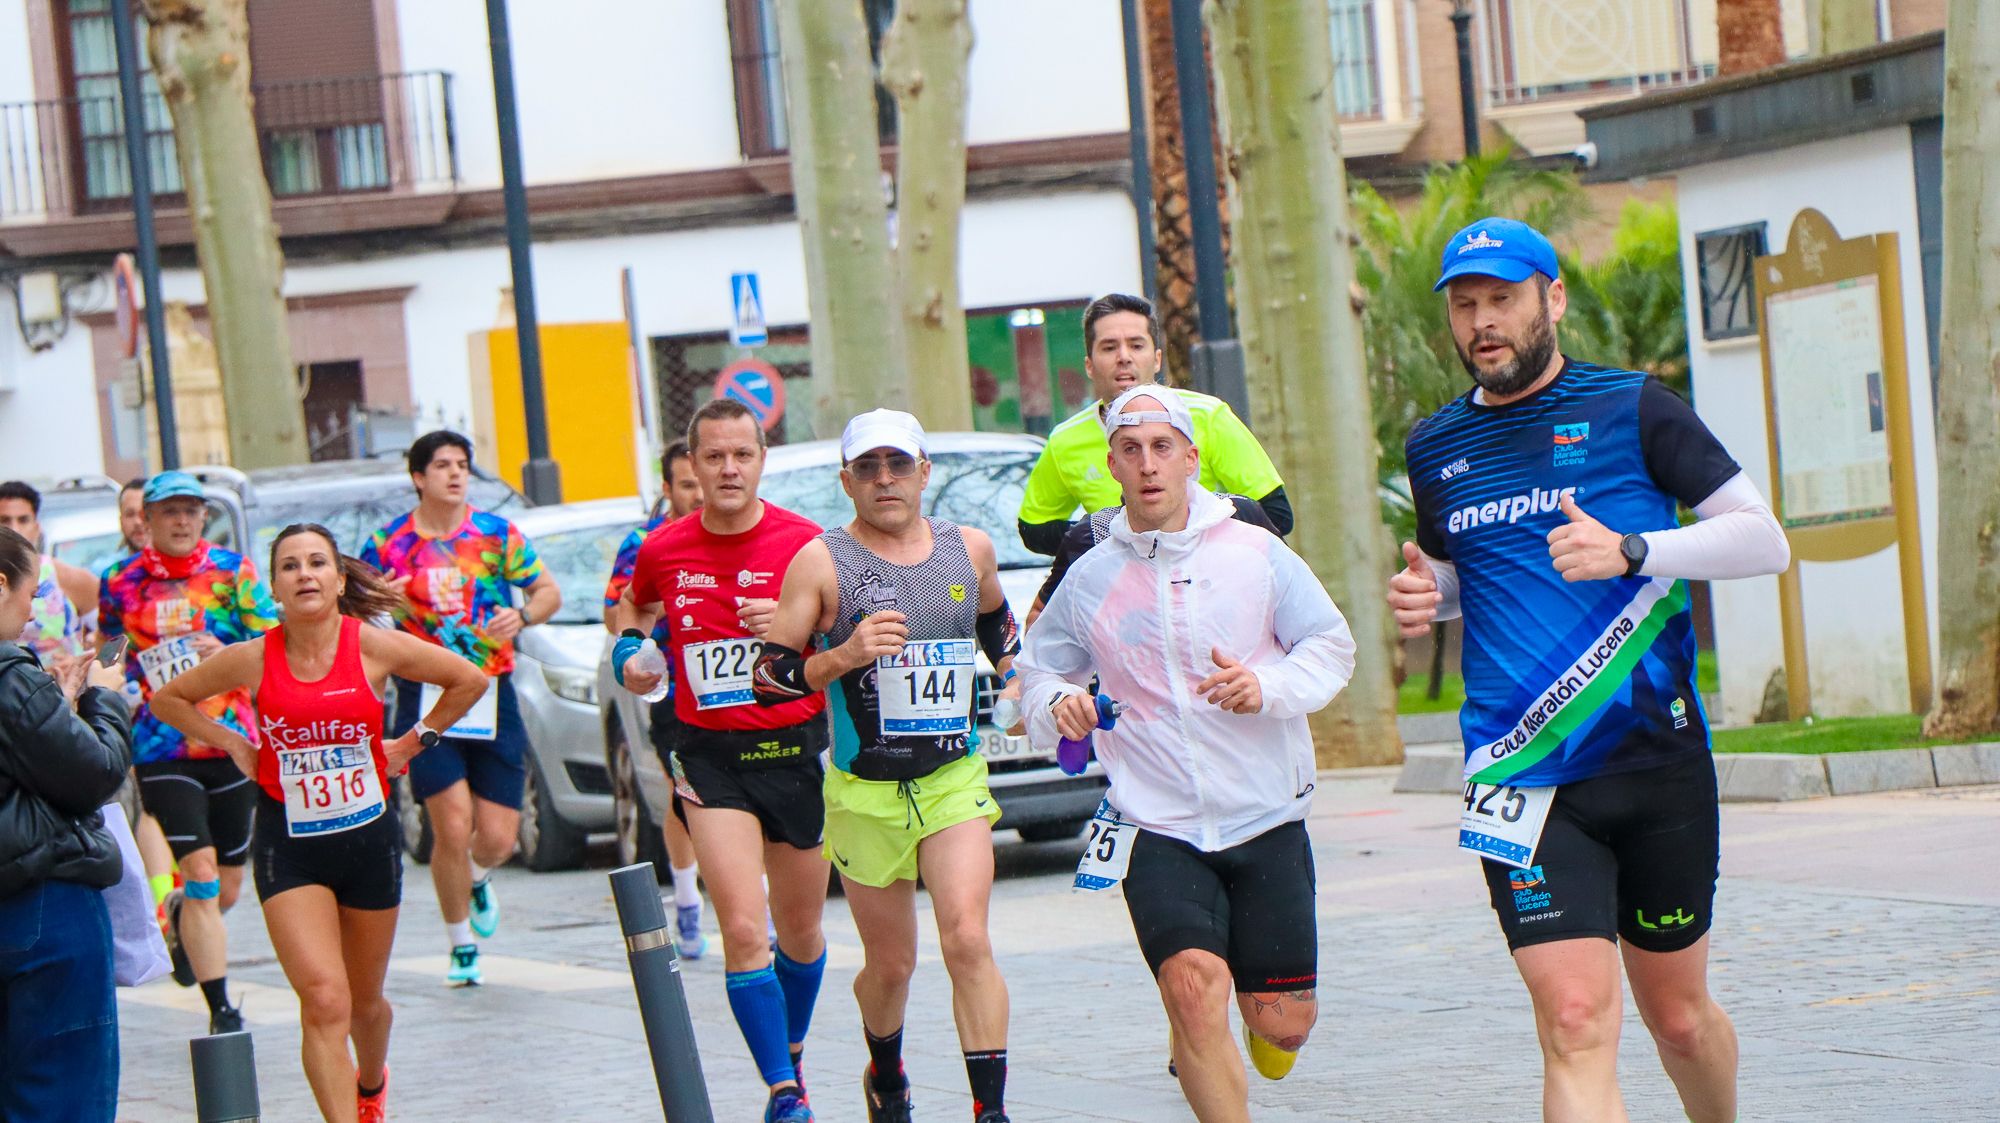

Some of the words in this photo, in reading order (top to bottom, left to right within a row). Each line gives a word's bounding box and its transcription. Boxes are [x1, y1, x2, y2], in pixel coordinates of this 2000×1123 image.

[1453, 464, 1469, 475] PRO
[1553, 457, 1585, 467] Lucena
[684, 573, 716, 585] califas
[904, 669, 956, 706] 144
[1490, 727, 1527, 759] Club
[1522, 676, 1584, 736] Maratón
[1575, 616, 1634, 680] Lucena
[281, 719, 368, 744] califas
[292, 750, 325, 775] 21K
[740, 746, 801, 760] HANKER
[296, 768, 366, 809] 1316
[1463, 782, 1527, 823] 425
[1513, 888, 1532, 898] Club
[1516, 899, 1550, 912] Lucena
